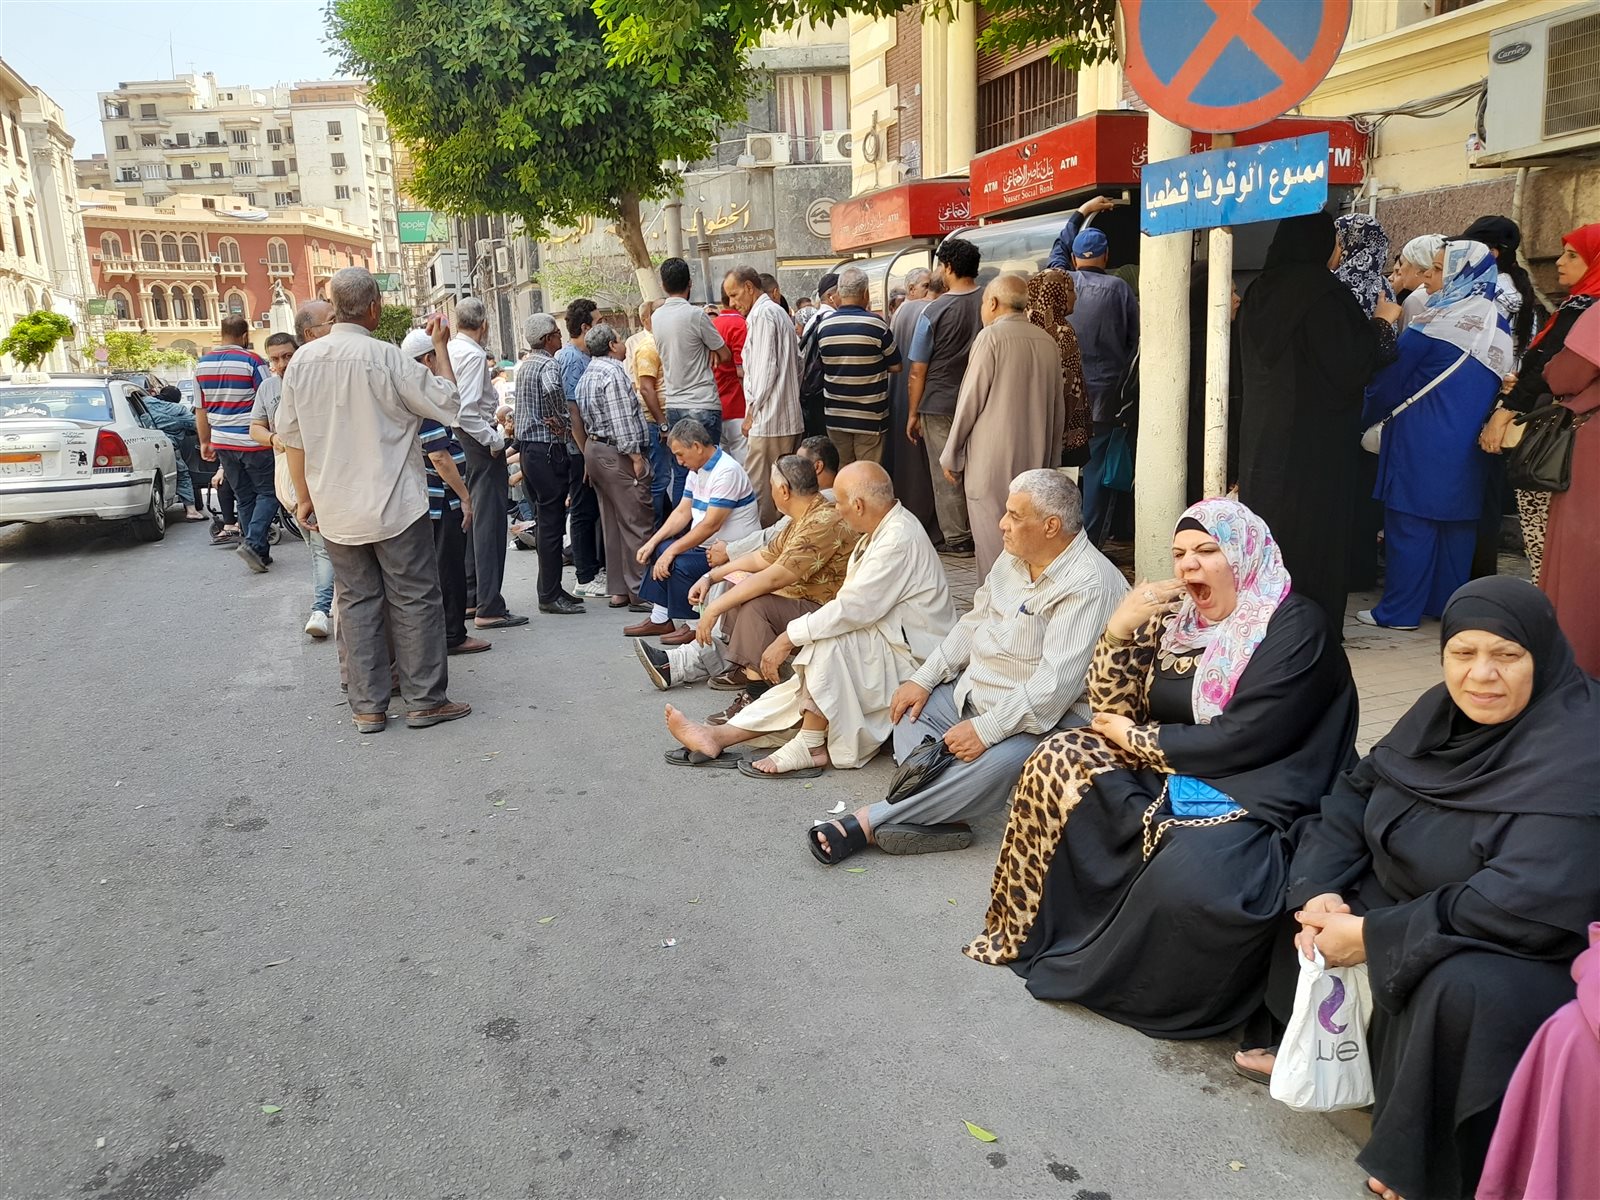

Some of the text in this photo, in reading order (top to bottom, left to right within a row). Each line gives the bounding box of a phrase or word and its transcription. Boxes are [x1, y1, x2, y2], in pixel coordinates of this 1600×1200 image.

[1497, 45, 1526, 59] Carrier
[1060, 155, 1078, 170] ATM
[983, 181, 998, 194] ATM
[1195, 160, 1262, 205] الوقوف
[1003, 181, 1054, 205] Nasser Social Bank
[1145, 171, 1189, 217] قطعيا
[400, 219, 425, 229] apple
[711, 245, 735, 254] Gawad
[735, 243, 756, 252] Hosny
